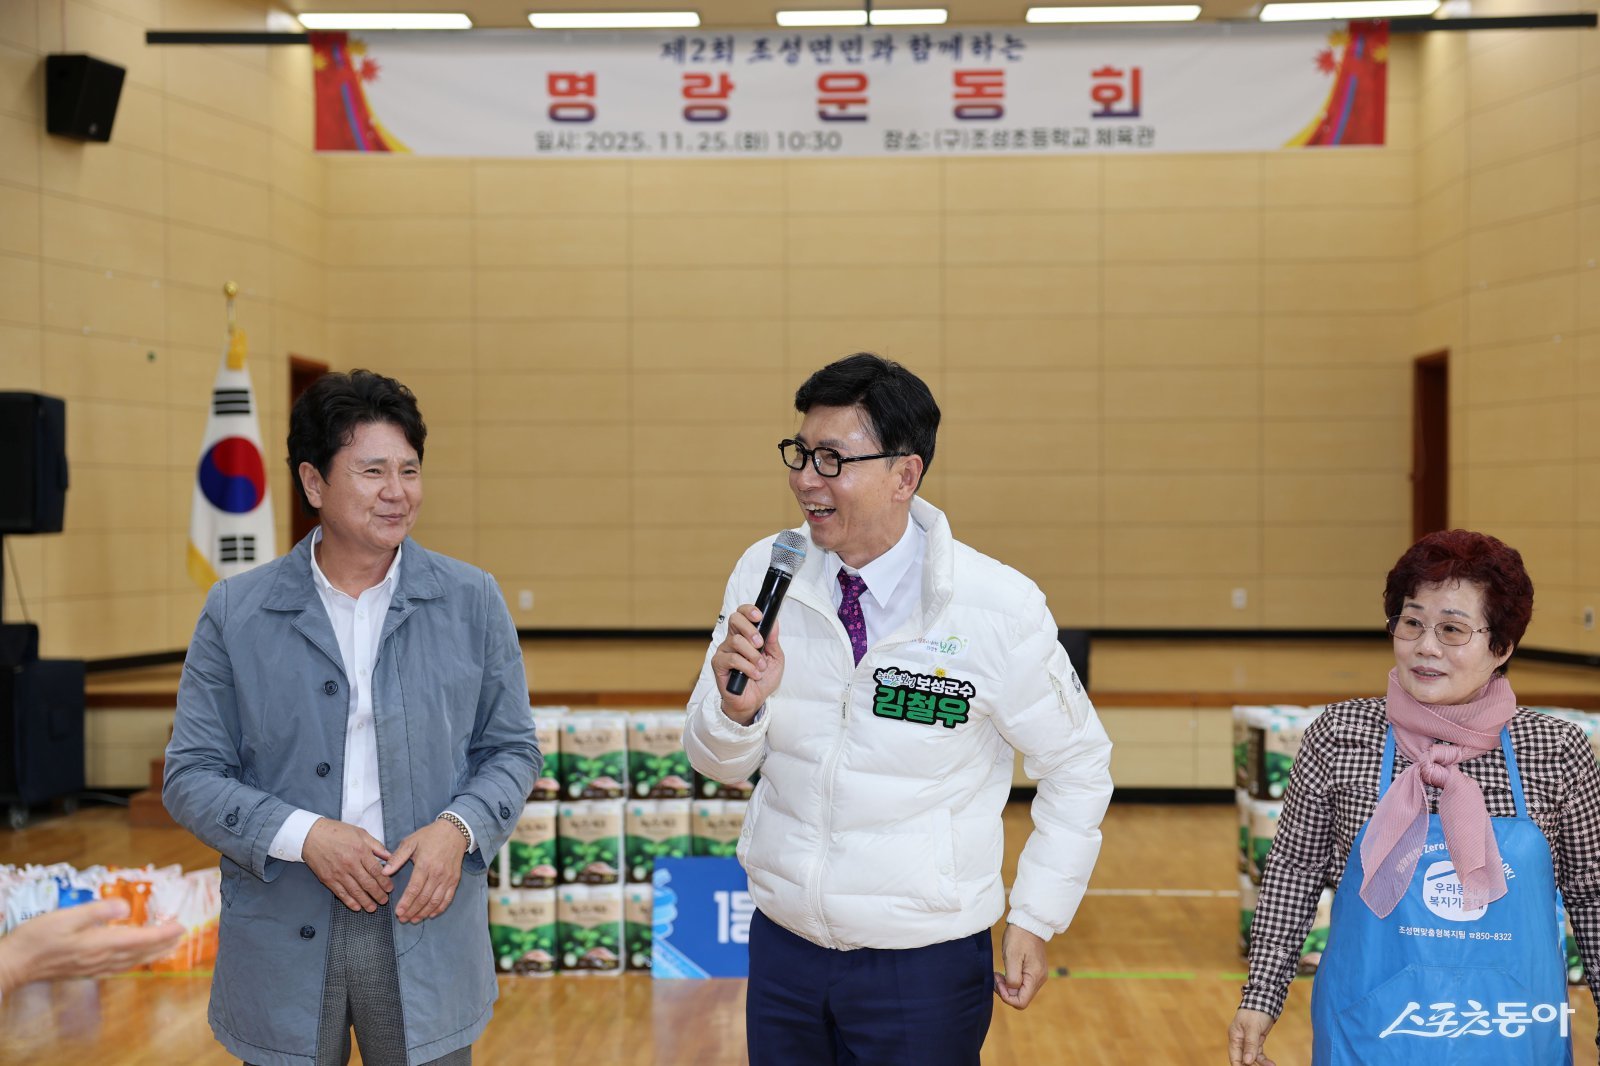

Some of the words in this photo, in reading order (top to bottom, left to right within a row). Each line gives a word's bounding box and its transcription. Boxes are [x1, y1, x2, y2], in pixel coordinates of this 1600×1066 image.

[660, 35, 735, 64] 제2회
[747, 34, 896, 65] 조성면민과
[907, 32, 1027, 63] 함께하는
[915, 676, 973, 697] 보성군수
[875, 687, 968, 726] 김철우
[1424, 841, 1448, 853] Zero!
